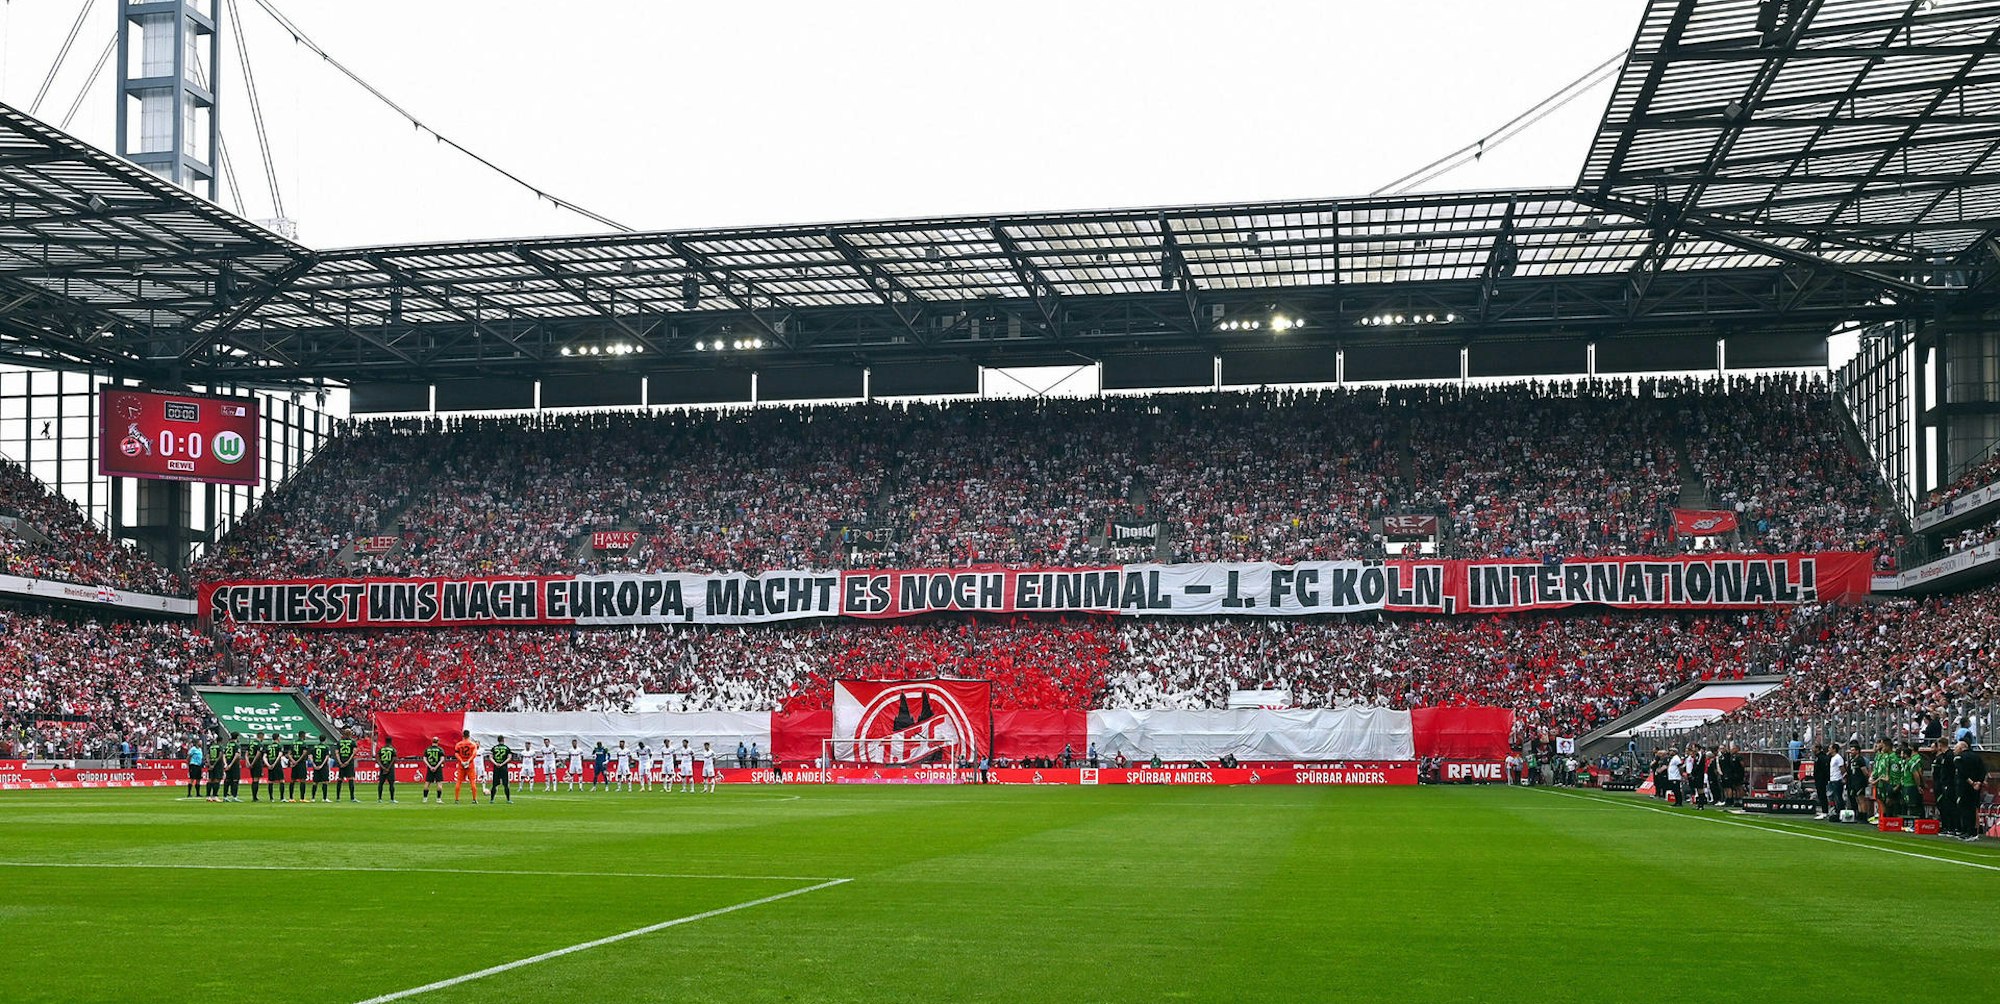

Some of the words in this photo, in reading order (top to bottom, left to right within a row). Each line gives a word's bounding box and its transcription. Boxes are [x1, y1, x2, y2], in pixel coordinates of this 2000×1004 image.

[159, 430, 202, 459] 0:0
[169, 461, 194, 470] REWE
[1384, 516, 1435, 528] RE7
[1115, 522, 1157, 539] TROIKA
[211, 584, 366, 623] SCHIESST
[369, 583, 437, 621] UNS
[444, 581, 538, 620] NACH
[546, 580, 694, 622] EUROPA,
[706, 576, 837, 617] MACHT
[846, 574, 891, 613] ES
[901, 573, 1004, 611] NOCH
[1015, 570, 1172, 610] EINMAL
[1221, 570, 1256, 608] 1.
[1270, 569, 1319, 608] FC
[1332, 560, 1455, 614] KÖLN,
[1469, 558, 1818, 607] INTERNATIONAL!
[234, 706, 280, 715] Mer
[222, 714, 278, 722] stonn
[248, 723, 293, 731] Dir!
[315, 748, 322, 760] 9
[340, 743, 351, 754] 25
[461, 745, 470, 757] 12
[381, 750, 392, 761] 20
[428, 751, 438, 761] 24
[355, 770, 380, 781] NDER
[751, 769, 794, 783] SPÜRAR
[1126, 769, 1171, 783] SPÜRBAR
[1174, 772, 1216, 783] ANDERS.
[1296, 769, 1342, 783] SPÜRBAR
[1345, 772, 1388, 783] ANDERS.
[1448, 764, 1502, 779] REWE
